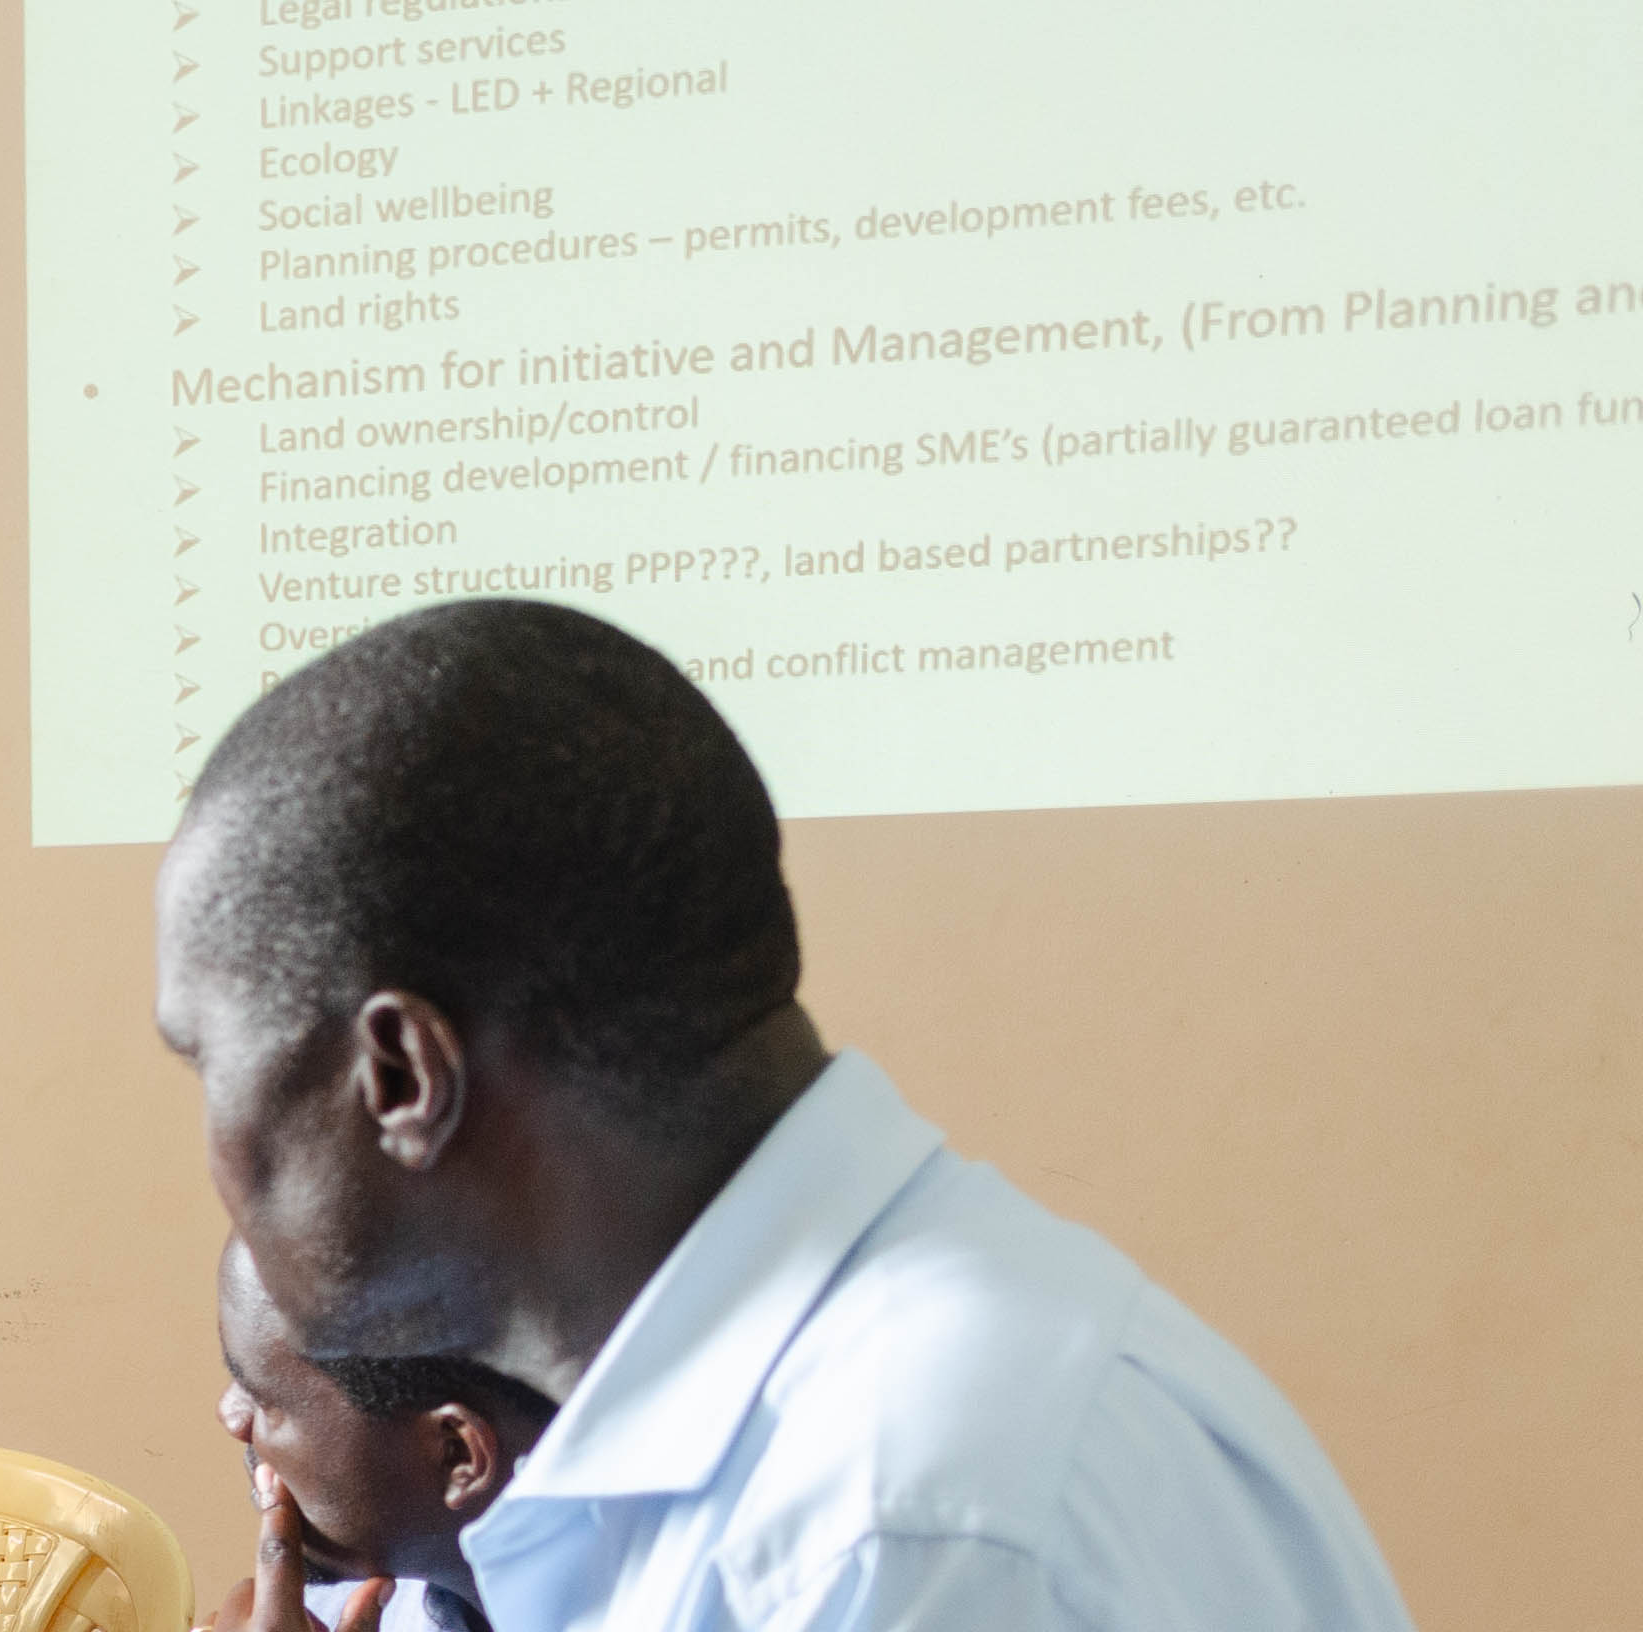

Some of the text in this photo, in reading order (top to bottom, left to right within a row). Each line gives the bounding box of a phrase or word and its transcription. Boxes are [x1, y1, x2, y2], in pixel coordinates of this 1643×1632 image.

[260, 0, 352, 30] Legal
[259, 26, 566, 81] Support services
[260, 92, 414, 129] Linkages
[452, 77, 520, 115] LED
[567, 60, 728, 109] Regional
[260, 141, 399, 179] Ecology
[258, 182, 555, 232] Social wellbeing
[260, 244, 417, 281] Planning
[428, 229, 638, 277] procedures
[684, 213, 841, 261] permits,
[855, 192, 1116, 240] development
[1127, 185, 1220, 221] fees,
[1234, 180, 1305, 213] etc.
[260, 290, 460, 333] Land rights
[172, 281, 1643, 407] Mechanism for initiative and Management, (From Planning an
[260, 395, 699, 454] Land ownership/control
[260, 465, 432, 504] Financing
[443, 450, 689, 494] development
[729, 438, 904, 477] financing
[1042, 417, 1217, 467] (partially
[1228, 400, 1461, 456] guaranteed
[1475, 398, 1563, 433] loan
[258, 516, 1298, 603] Venture structuring PPP???, land based partnerships??
[260, 515, 457, 558] Integration
[683, 631, 1175, 685] and conflict management
